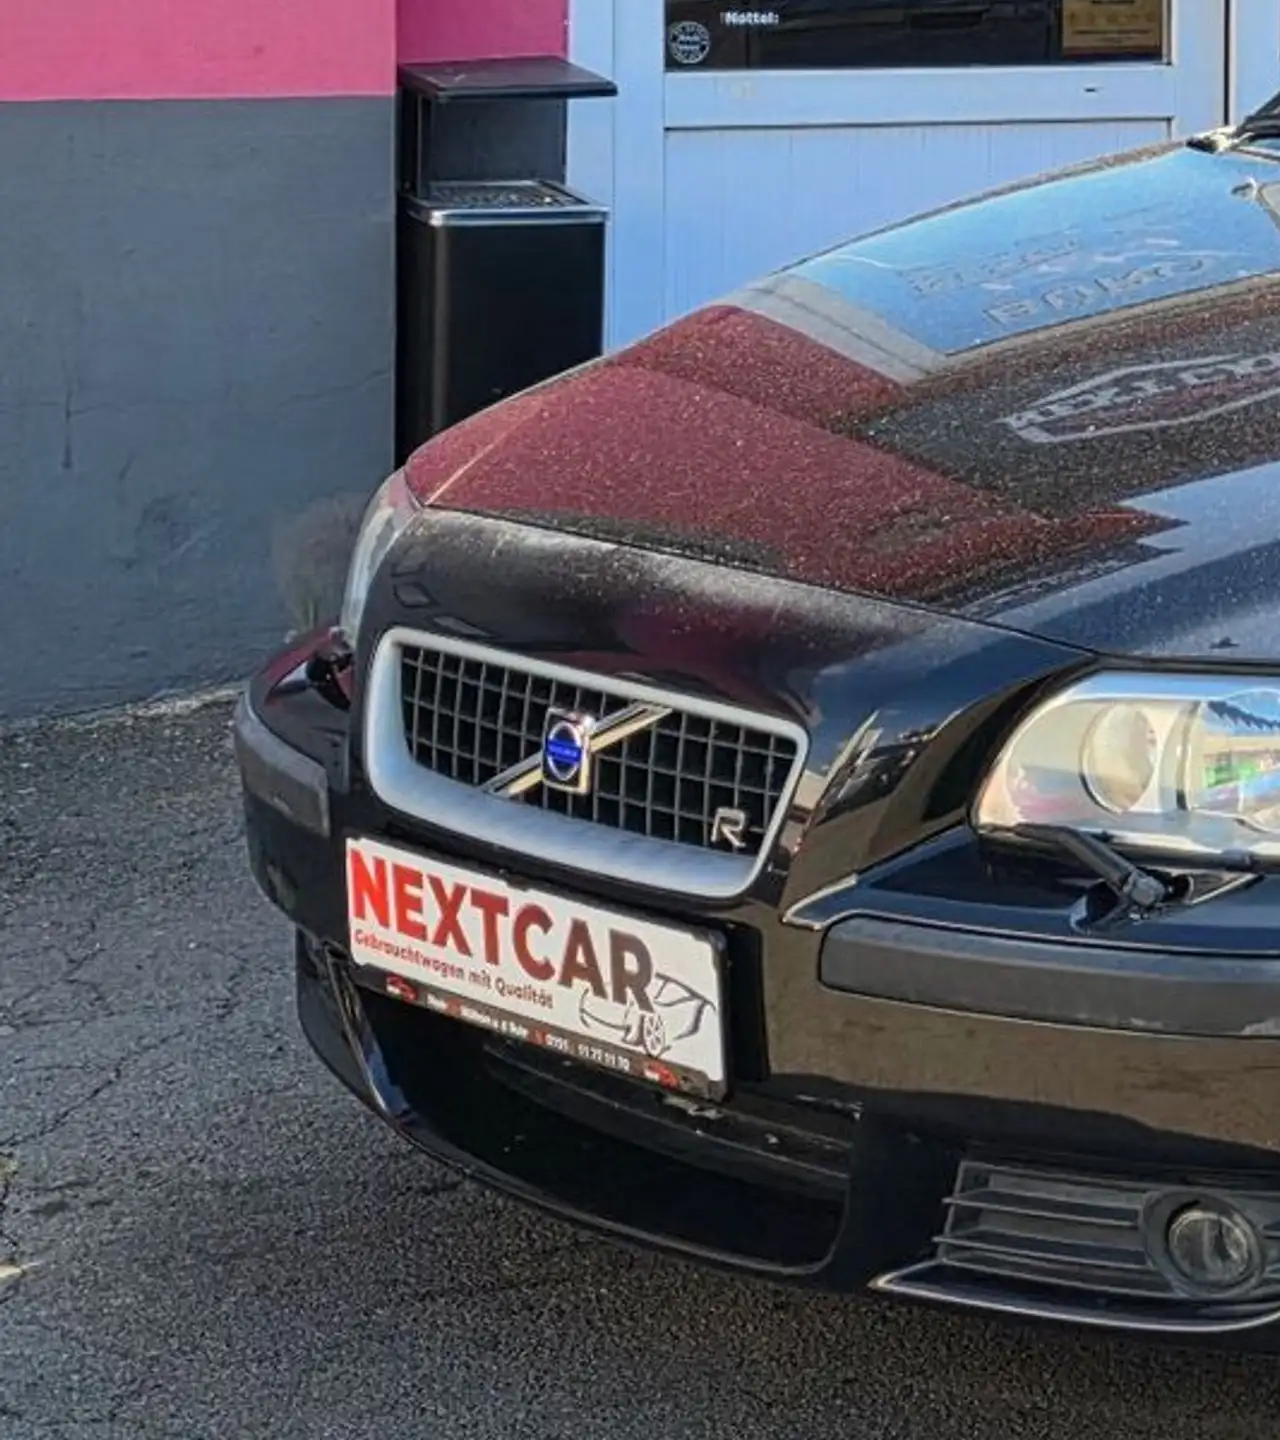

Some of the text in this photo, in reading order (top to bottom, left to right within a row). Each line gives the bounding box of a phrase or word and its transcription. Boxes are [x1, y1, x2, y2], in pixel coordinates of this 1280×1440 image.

[711, 807, 747, 849] R
[350, 848, 656, 1013] NEXTCAR
[353, 926, 465, 982] Gebrauchtwagen
[468, 967, 493, 991] mit
